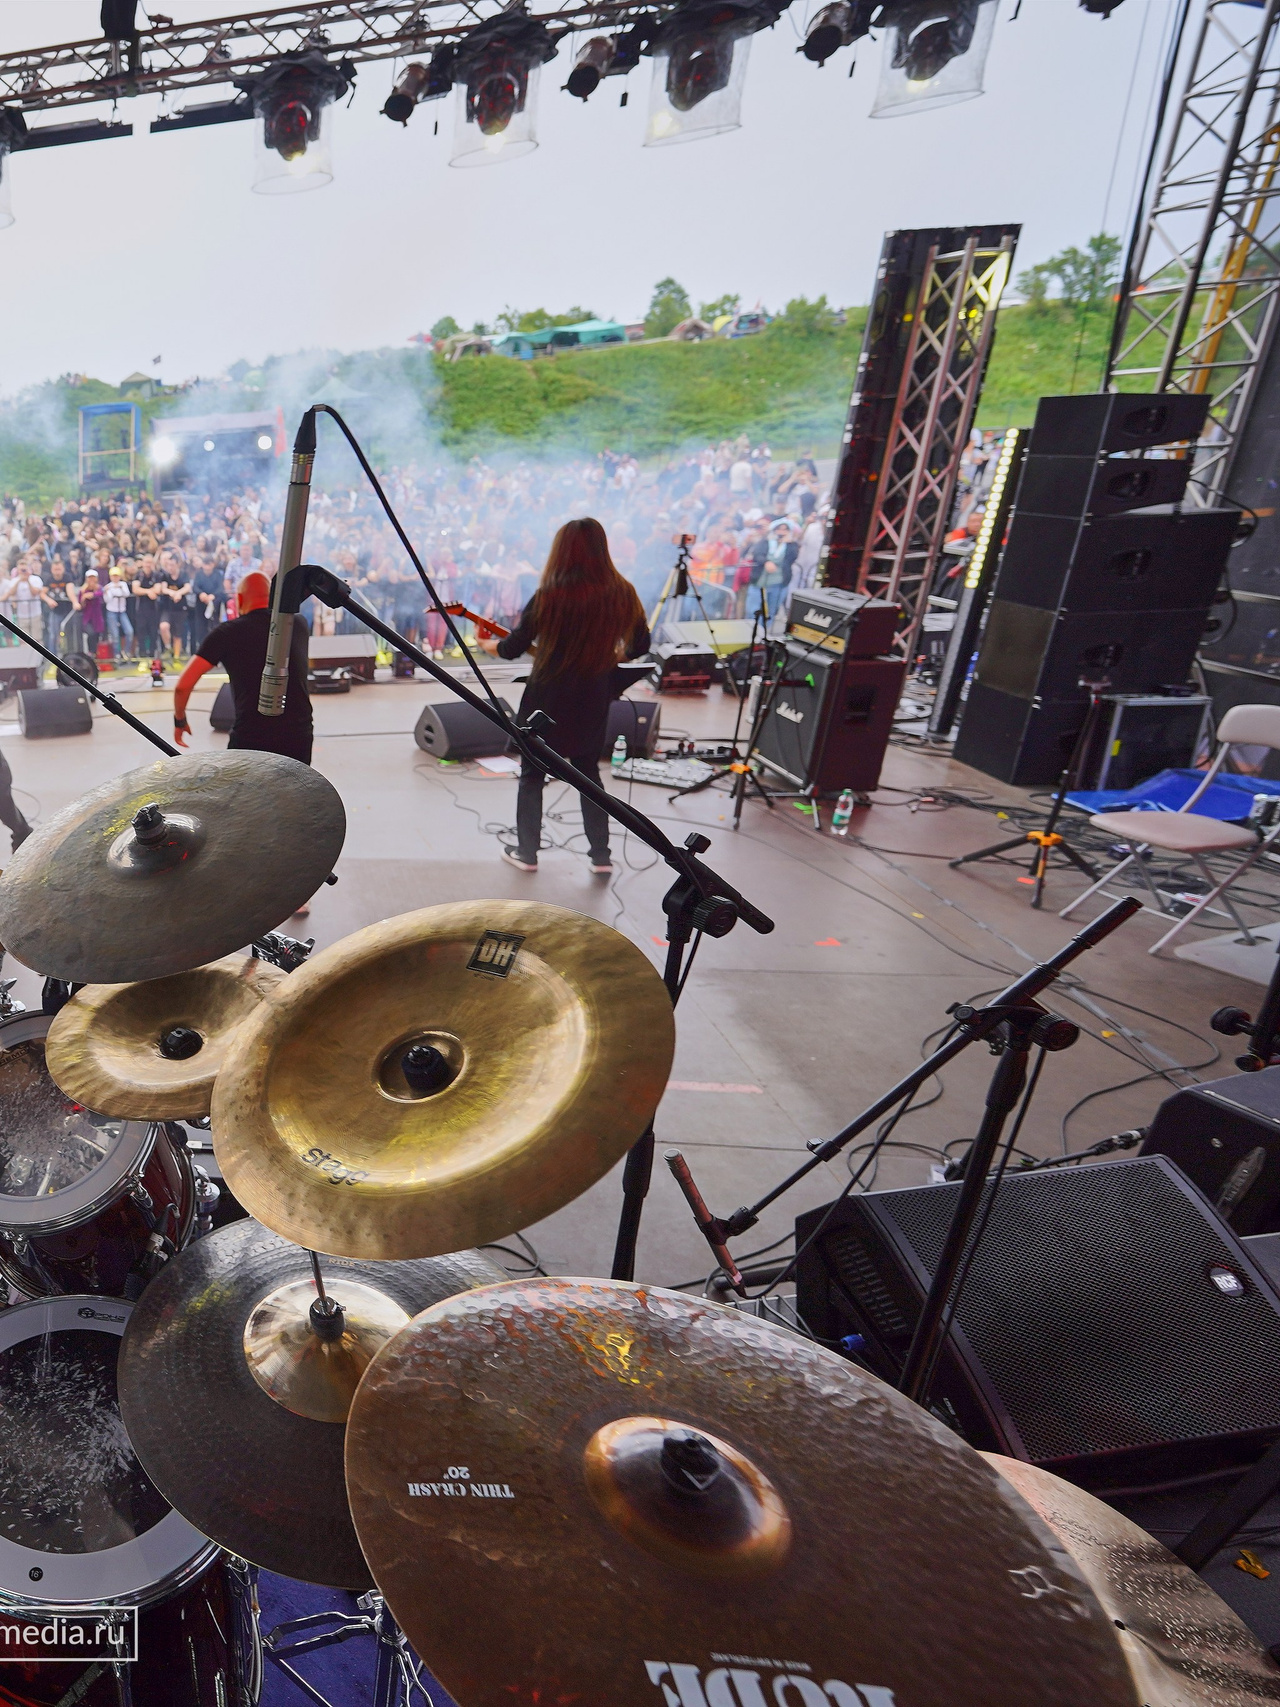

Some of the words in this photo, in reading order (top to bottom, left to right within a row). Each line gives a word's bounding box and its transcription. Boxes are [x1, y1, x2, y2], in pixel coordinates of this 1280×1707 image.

[477, 938, 516, 967] DH
[300, 1147, 371, 1186] Stagg
[1212, 1274, 1238, 1290] RCF
[406, 1482, 467, 1497] CRASH
[469, 1483, 515, 1499] THIN
